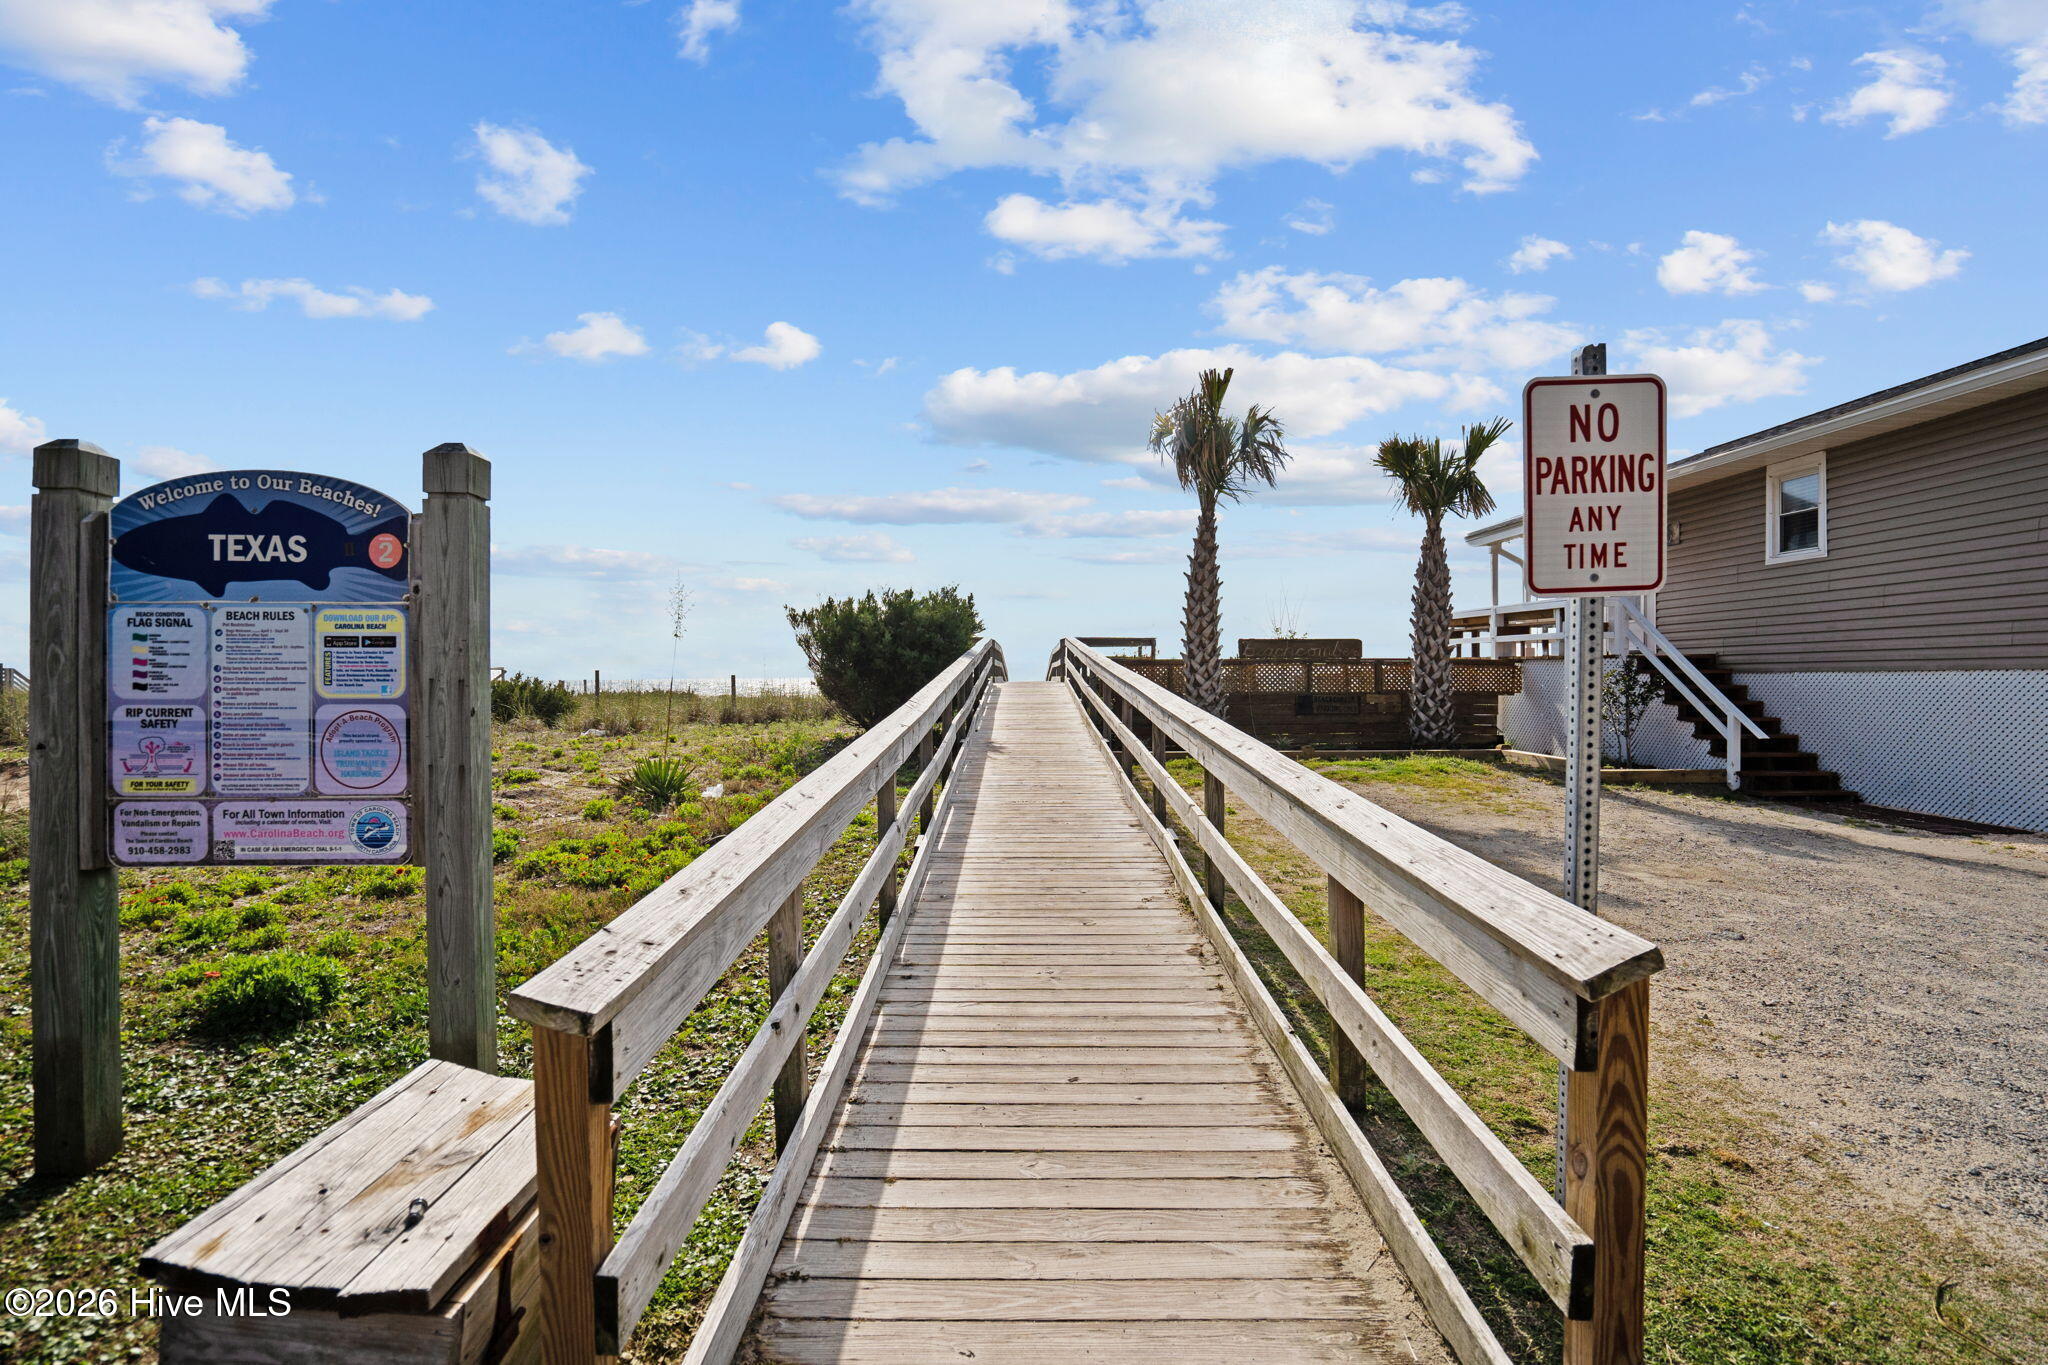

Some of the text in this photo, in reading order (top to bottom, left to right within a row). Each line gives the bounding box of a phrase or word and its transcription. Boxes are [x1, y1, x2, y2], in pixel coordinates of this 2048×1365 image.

[1569, 402, 1620, 443] NO
[1535, 453, 1655, 495] PARKING
[137, 473, 383, 518] Welcome to Our Beaches!
[1568, 505, 1622, 532] ANY
[208, 534, 308, 563] TEXAS
[378, 542, 393, 562] 2
[1563, 541, 1628, 569] TIME
[226, 611, 295, 620] BEACH RULES
[324, 614, 363, 622] DOWNLOAD
[366, 614, 380, 622] OUR
[127, 618, 193, 628] FLAG SIGNAL
[126, 708, 194, 718] RIP CURRENT
[140, 719, 178, 728] SAFETY
[374, 717, 396, 743] Program
[134, 809, 202, 817] Non-Emergencies,
[222, 810, 345, 819] For All Town Information
[172, 820, 200, 828] Repairs
[224, 829, 345, 839] www.CarolinaBeach.org
[128, 846, 190, 854] 910-458-2983
